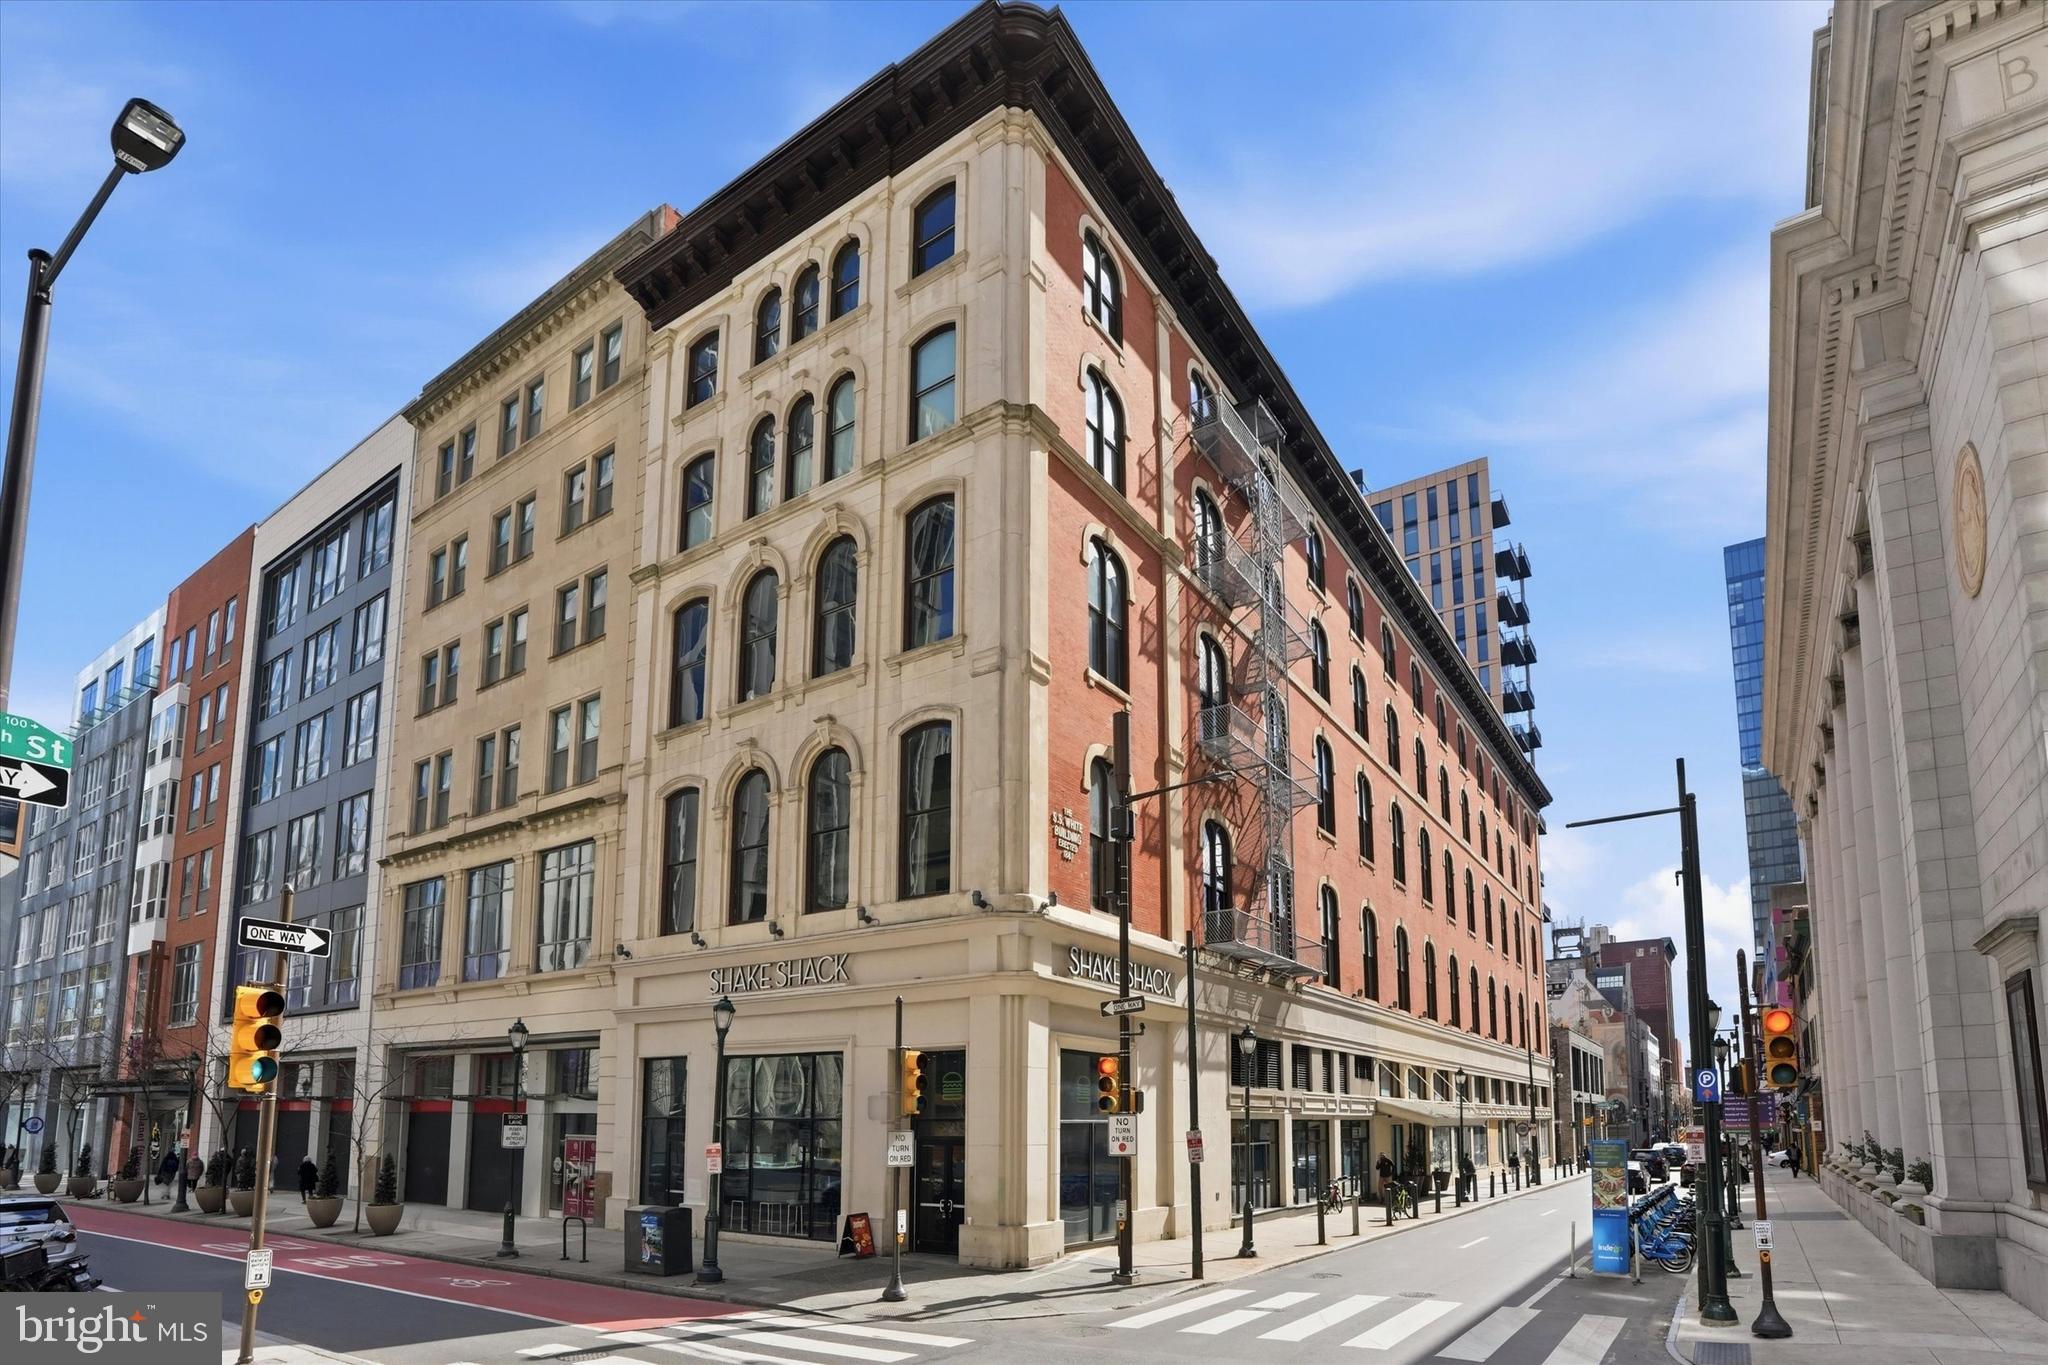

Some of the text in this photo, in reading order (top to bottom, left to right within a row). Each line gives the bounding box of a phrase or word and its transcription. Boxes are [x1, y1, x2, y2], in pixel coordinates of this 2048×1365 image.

[5, 716, 28, 729] 100
[26, 735, 65, 764] St
[0, 769, 19, 785] Y
[1064, 817, 1083, 835] WHITE
[1054, 825, 1082, 846] BUILDING
[250, 927, 305, 944] ONE WAY
[1068, 946, 1120, 985] SHAKE
[709, 953, 850, 994] SHAKE SHACK
[1127, 1000, 1140, 1008] WAY
[1116, 1117, 1129, 1126] NO
[895, 1134, 906, 1142] NO
[892, 1144, 910, 1152] TURN
[900, 1154, 912, 1162] RED
[288, 1255, 406, 1269] BUS
